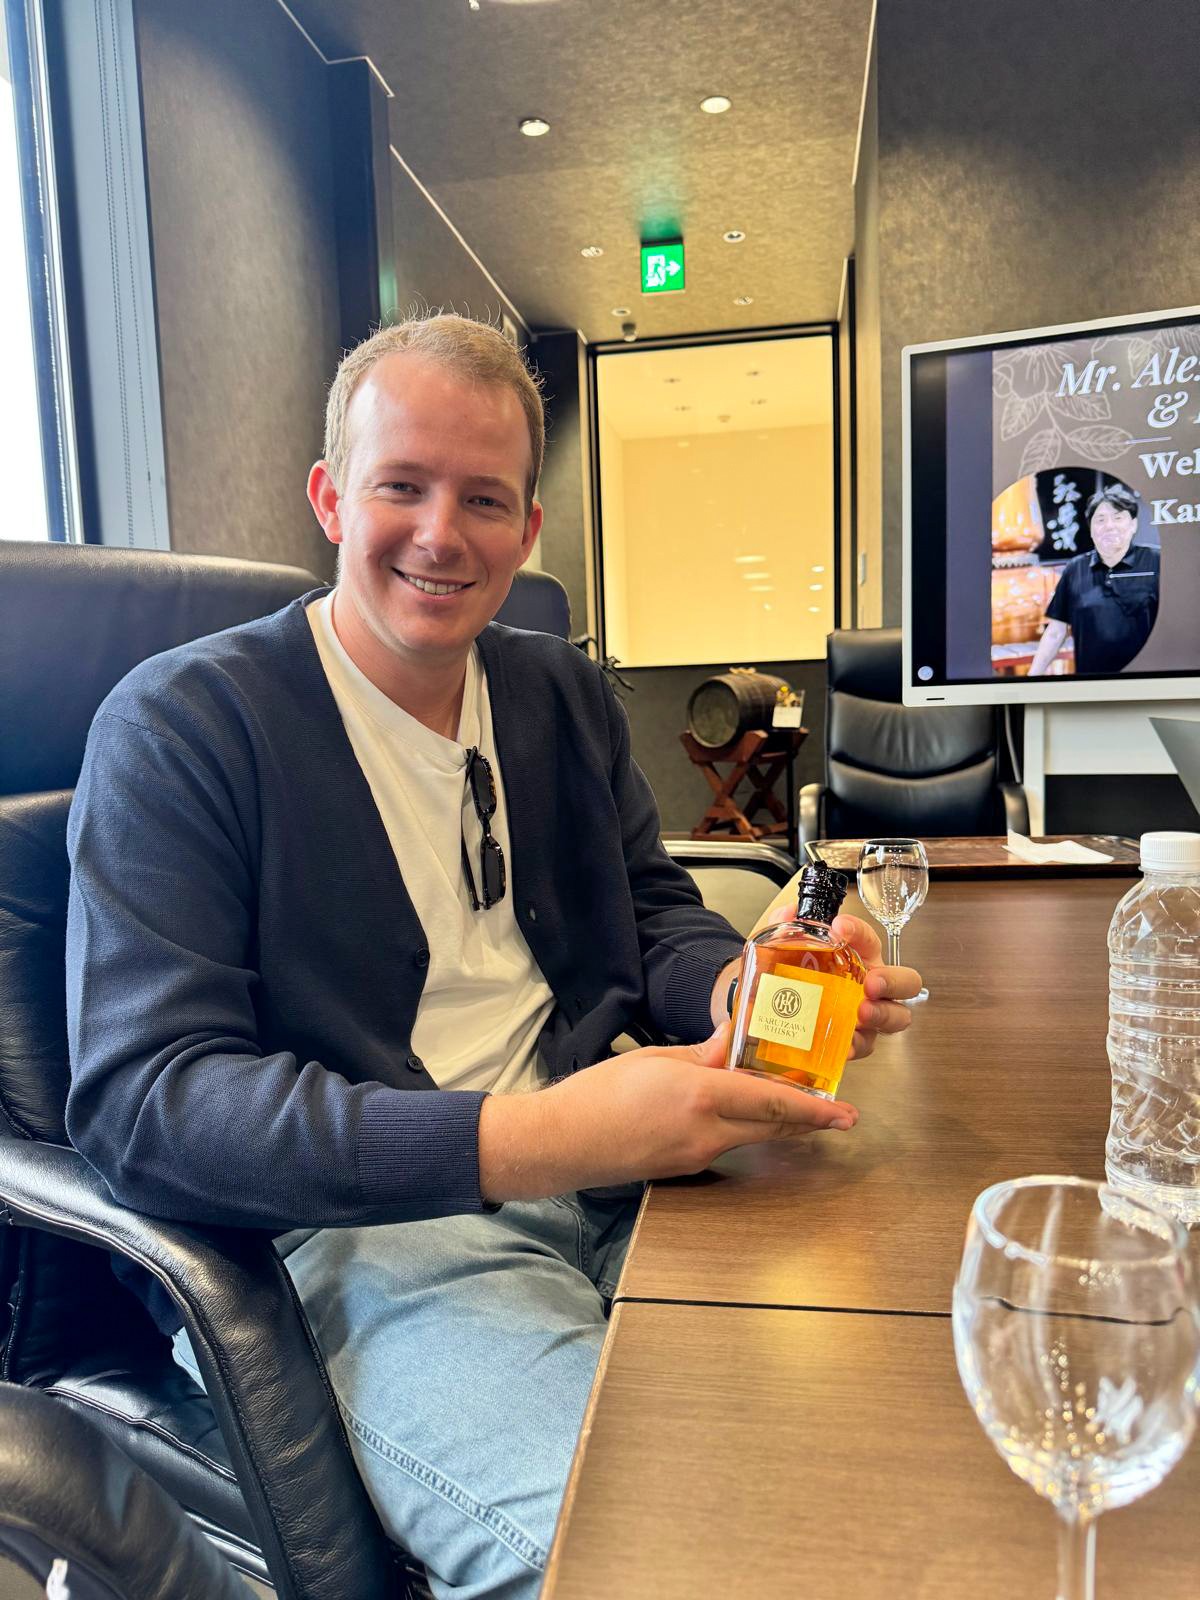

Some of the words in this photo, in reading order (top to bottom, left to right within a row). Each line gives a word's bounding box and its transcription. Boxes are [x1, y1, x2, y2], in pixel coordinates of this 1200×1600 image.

[1055, 360, 1121, 397] Mr.
[1147, 391, 1188, 428] &
[764, 1023, 798, 1038] WHISKY
